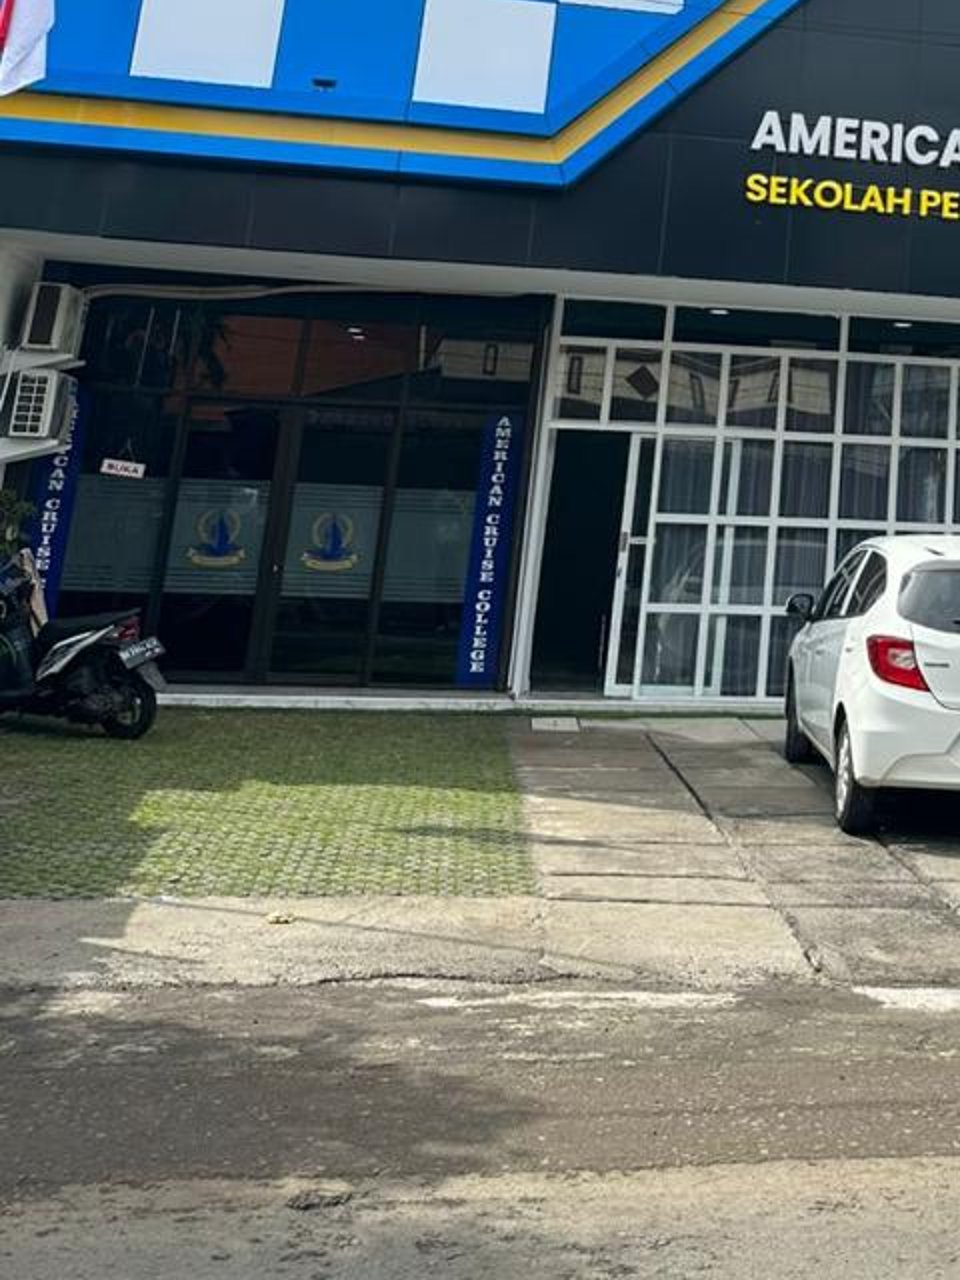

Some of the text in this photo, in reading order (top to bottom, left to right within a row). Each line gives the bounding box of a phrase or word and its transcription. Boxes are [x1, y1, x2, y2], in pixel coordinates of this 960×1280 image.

[745, 174, 911, 214] SEKOLAH
[36, 496, 61, 571] CRUISE
[469, 416, 512, 673] AMERICAN CRUISE COLLEGE
